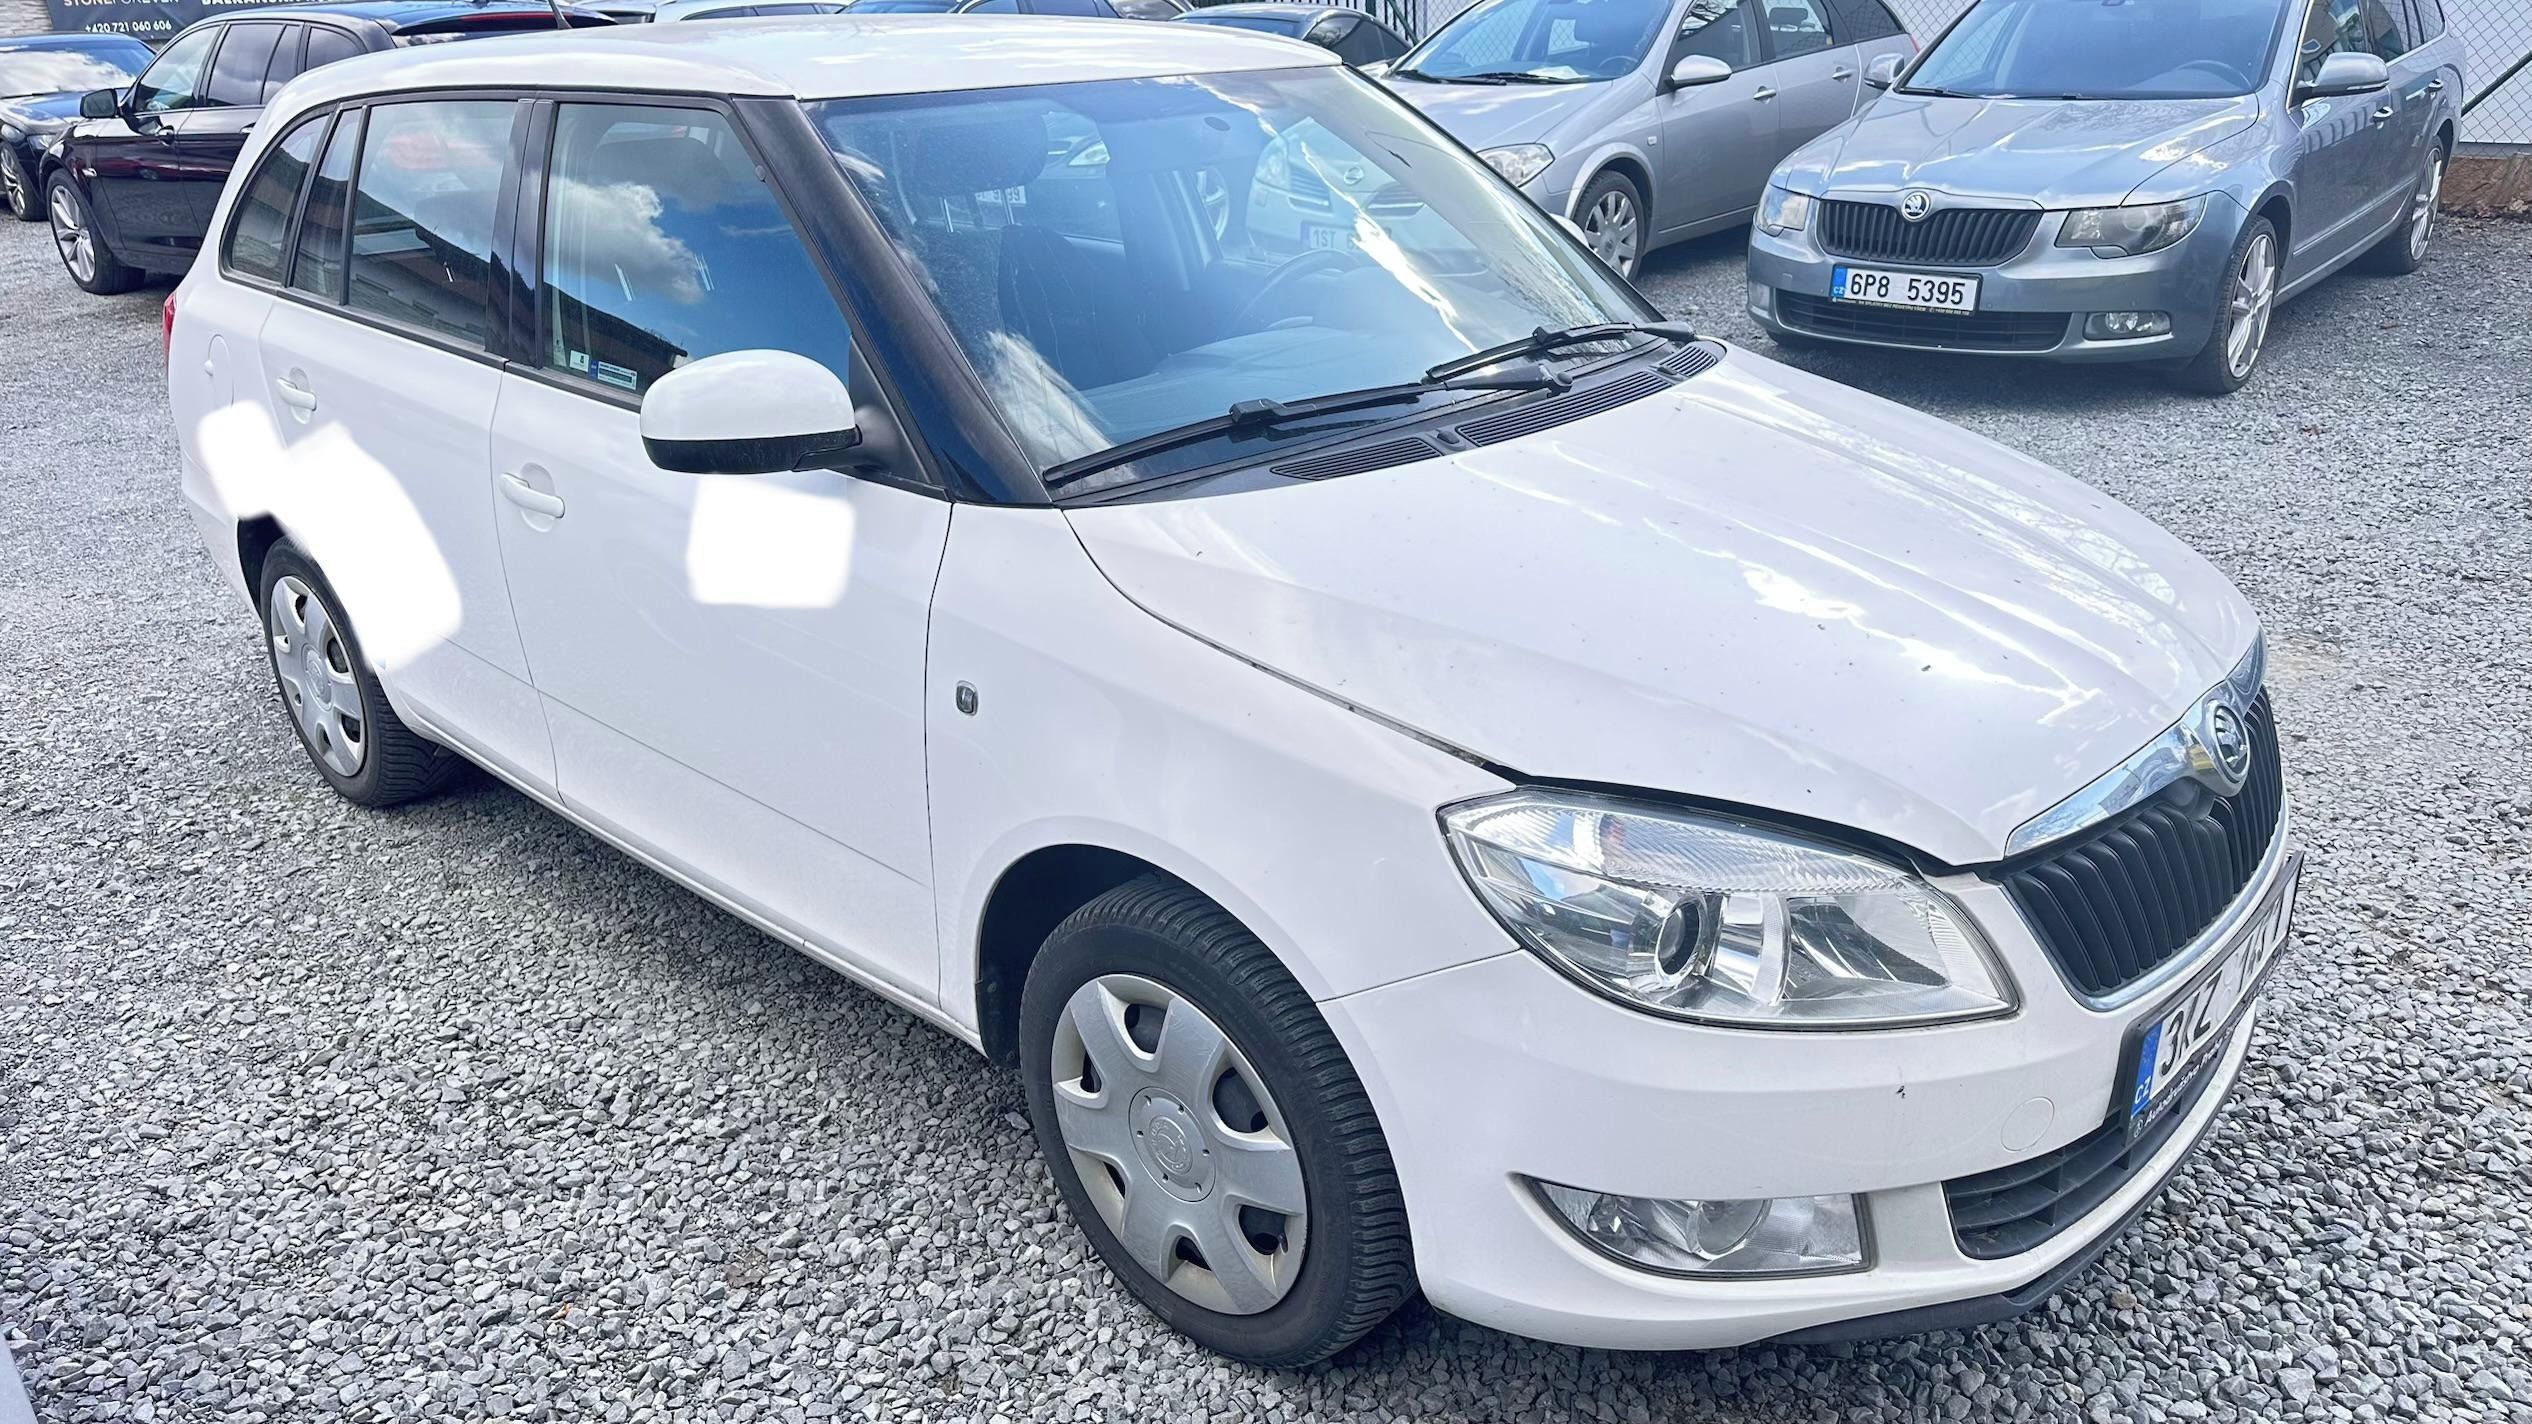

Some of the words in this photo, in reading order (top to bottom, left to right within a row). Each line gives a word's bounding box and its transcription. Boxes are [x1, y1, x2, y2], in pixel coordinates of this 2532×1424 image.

[85, 22, 111, 33] +420
[112, 22, 129, 32] 721
[132, 21, 151, 32] 060
[153, 20, 172, 30] 606
[1833, 285, 1845, 295] CZ
[1850, 273, 1890, 298] 6P8
[1907, 278, 1966, 305] 5395
[2134, 1075, 2152, 1104] CZ
